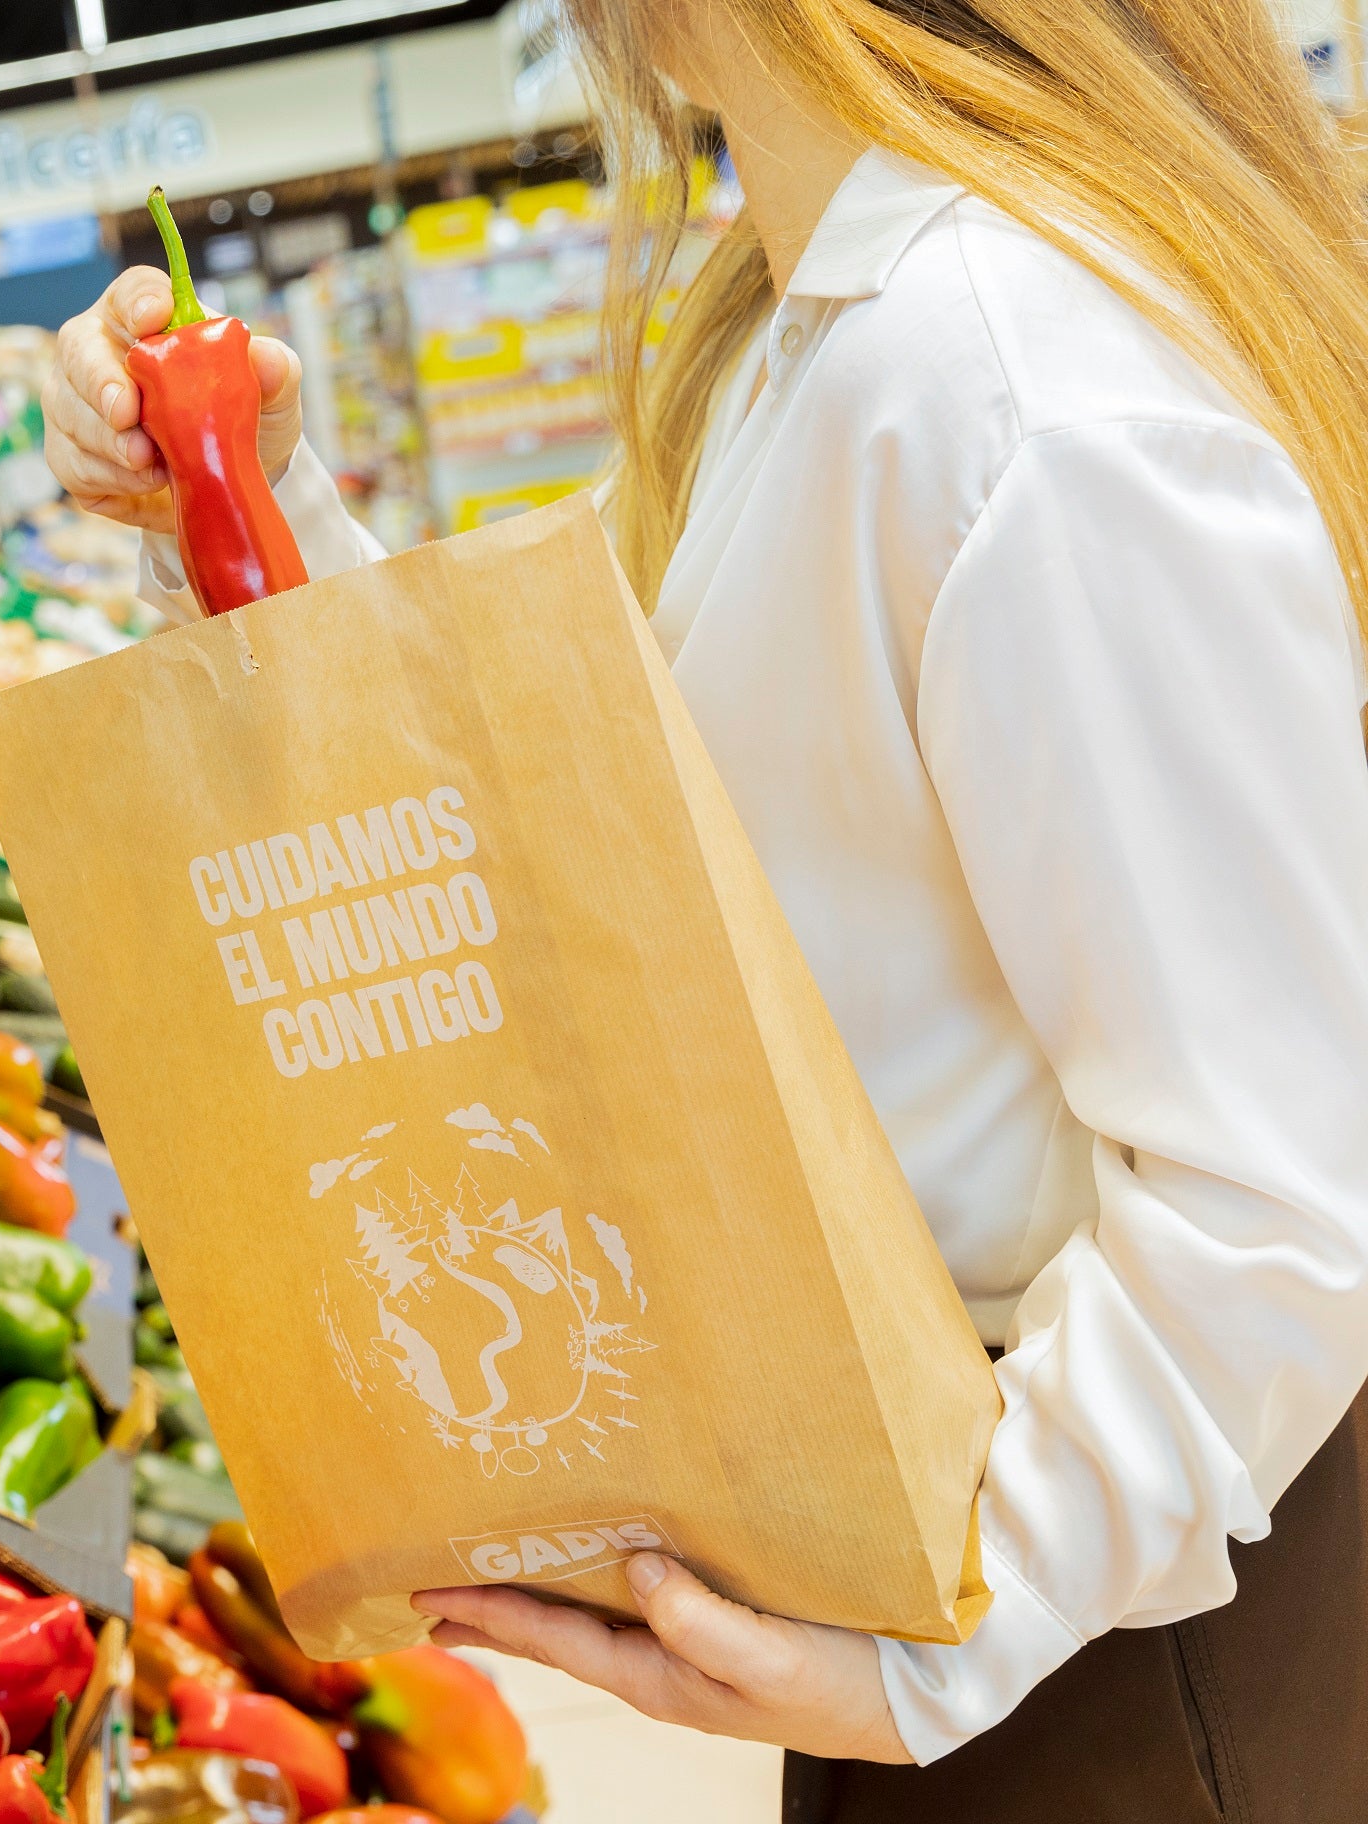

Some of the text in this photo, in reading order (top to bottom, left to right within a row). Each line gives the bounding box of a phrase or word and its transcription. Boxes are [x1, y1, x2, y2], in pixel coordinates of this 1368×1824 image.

[188, 786, 477, 927] CUIDAMOS
[216, 872, 498, 1006] EL MUNDO
[262, 960, 504, 1079] CONTIGO
[469, 1522, 663, 1580] GADIS
